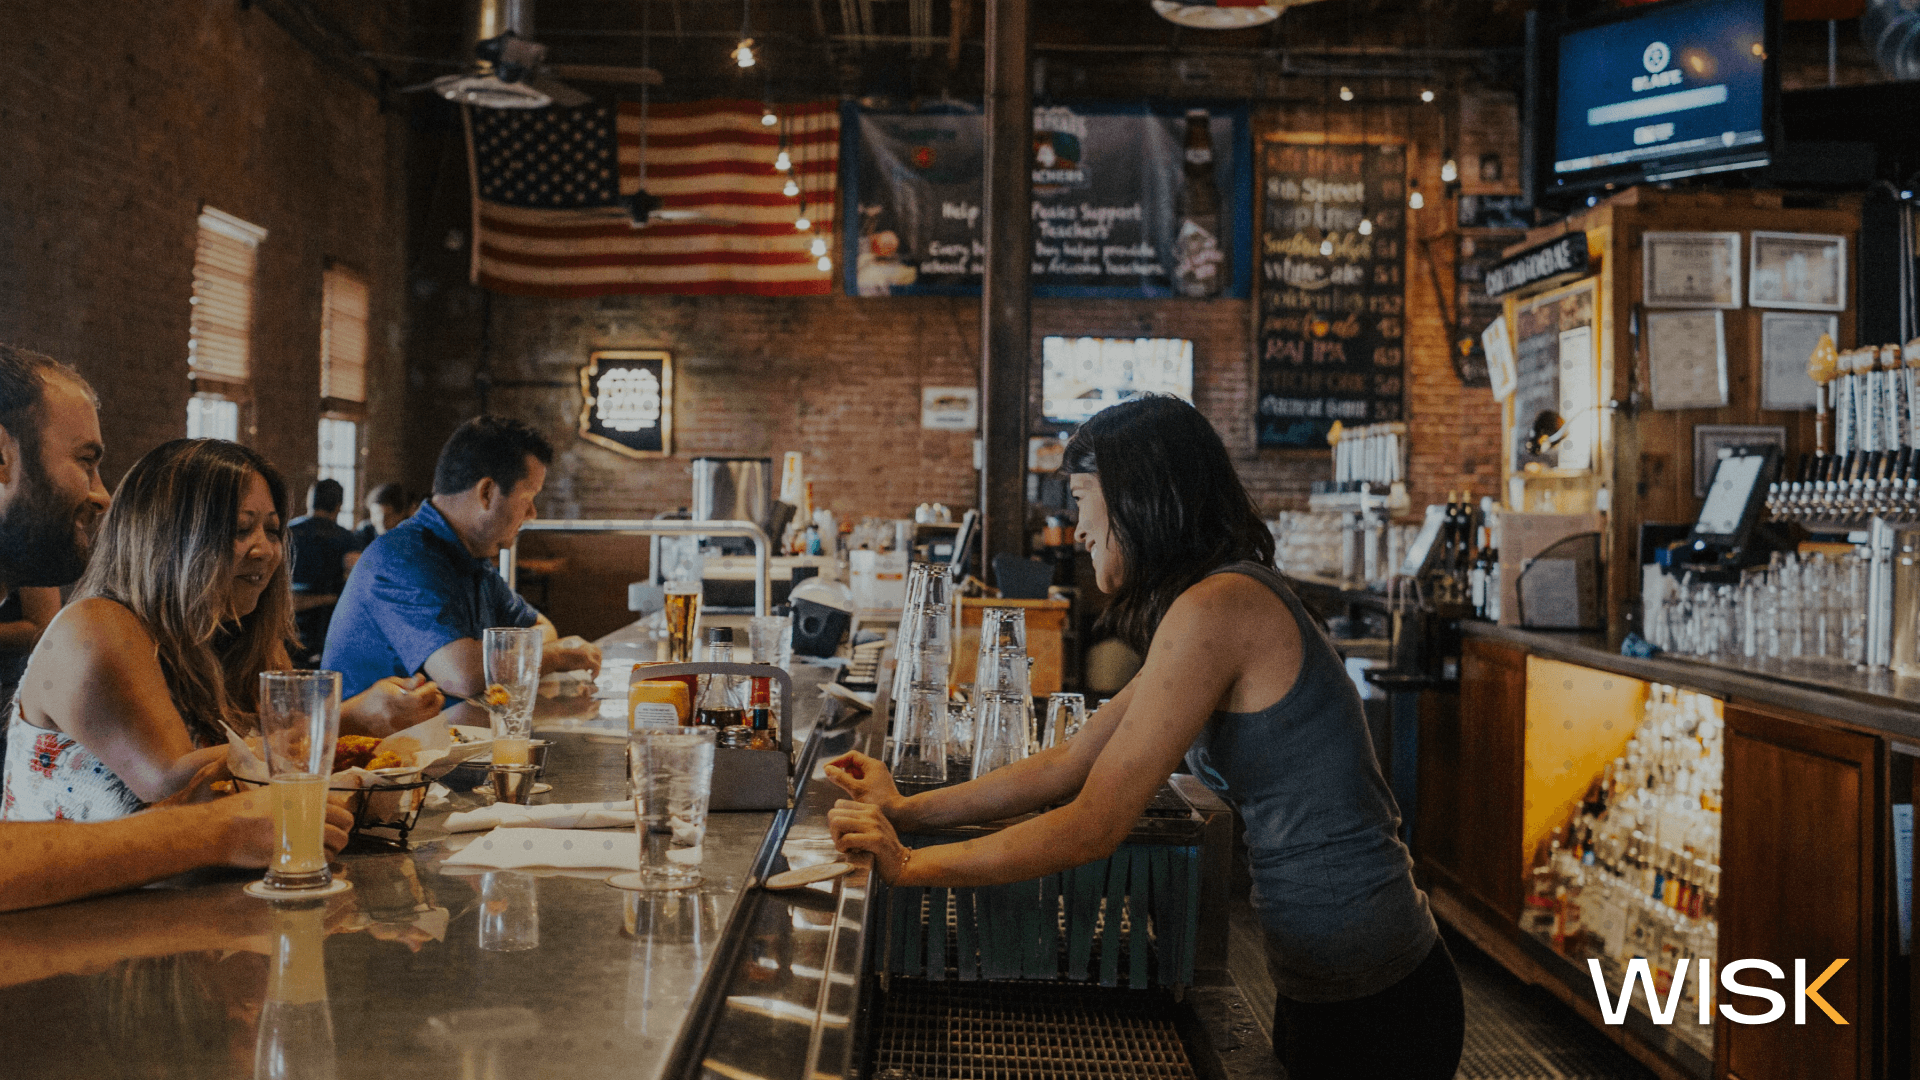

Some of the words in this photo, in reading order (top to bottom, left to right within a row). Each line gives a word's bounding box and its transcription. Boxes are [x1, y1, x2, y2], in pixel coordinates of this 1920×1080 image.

[1302, 178, 1364, 202] Street
[942, 202, 978, 229] Help
[1080, 202, 1142, 228] Support
